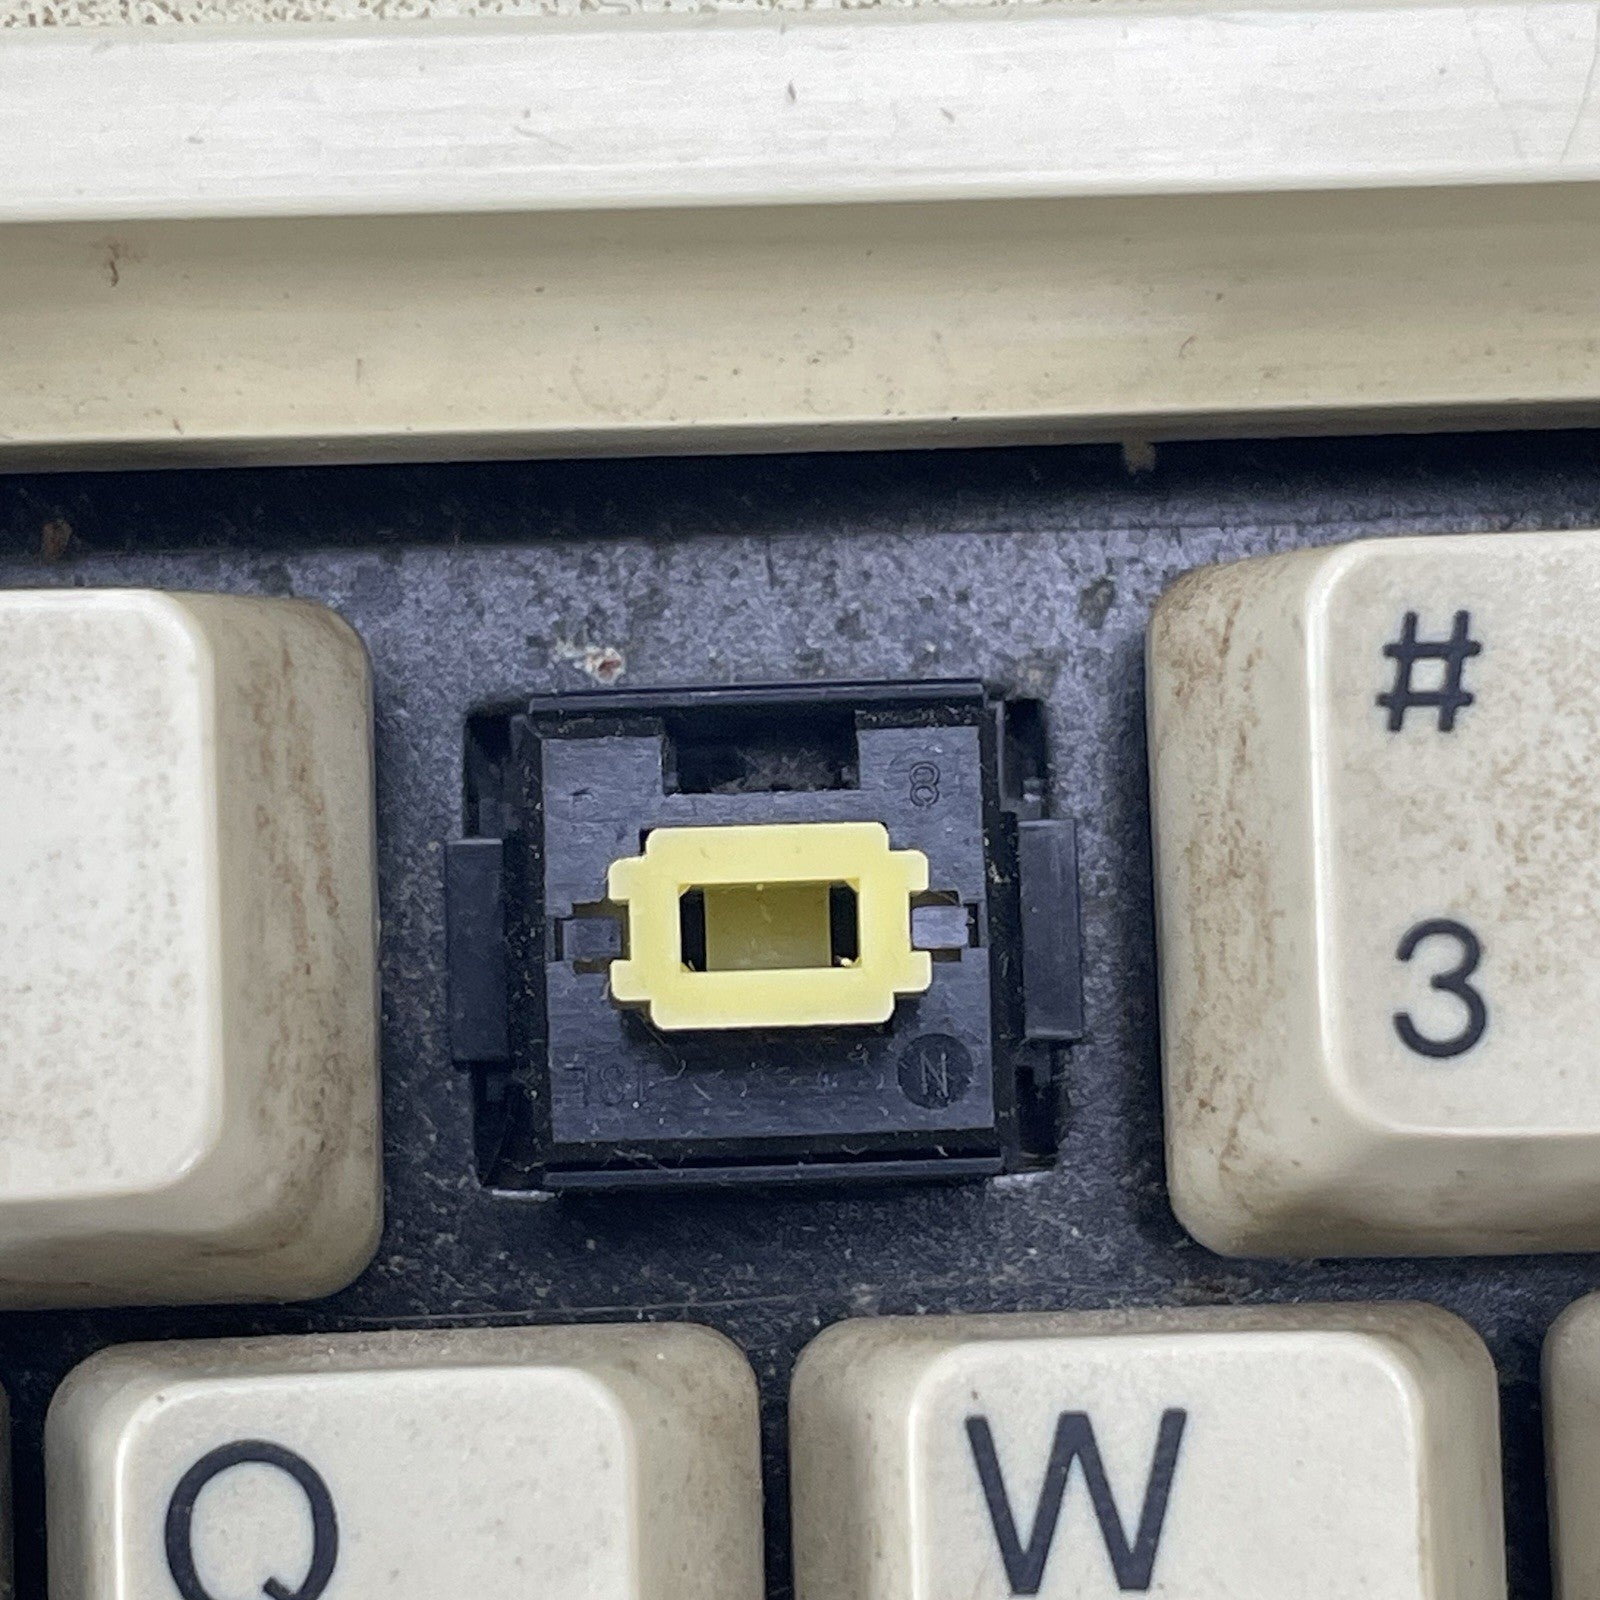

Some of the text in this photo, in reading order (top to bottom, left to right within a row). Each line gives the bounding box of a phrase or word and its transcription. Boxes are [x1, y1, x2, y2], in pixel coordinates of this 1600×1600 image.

[1375, 610, 1482, 732] #
[909, 761, 940, 807] 8
[1393, 918, 1487, 1058] 3
[165, 1439, 339, 1600] Q
[965, 1408, 1187, 1595] W
